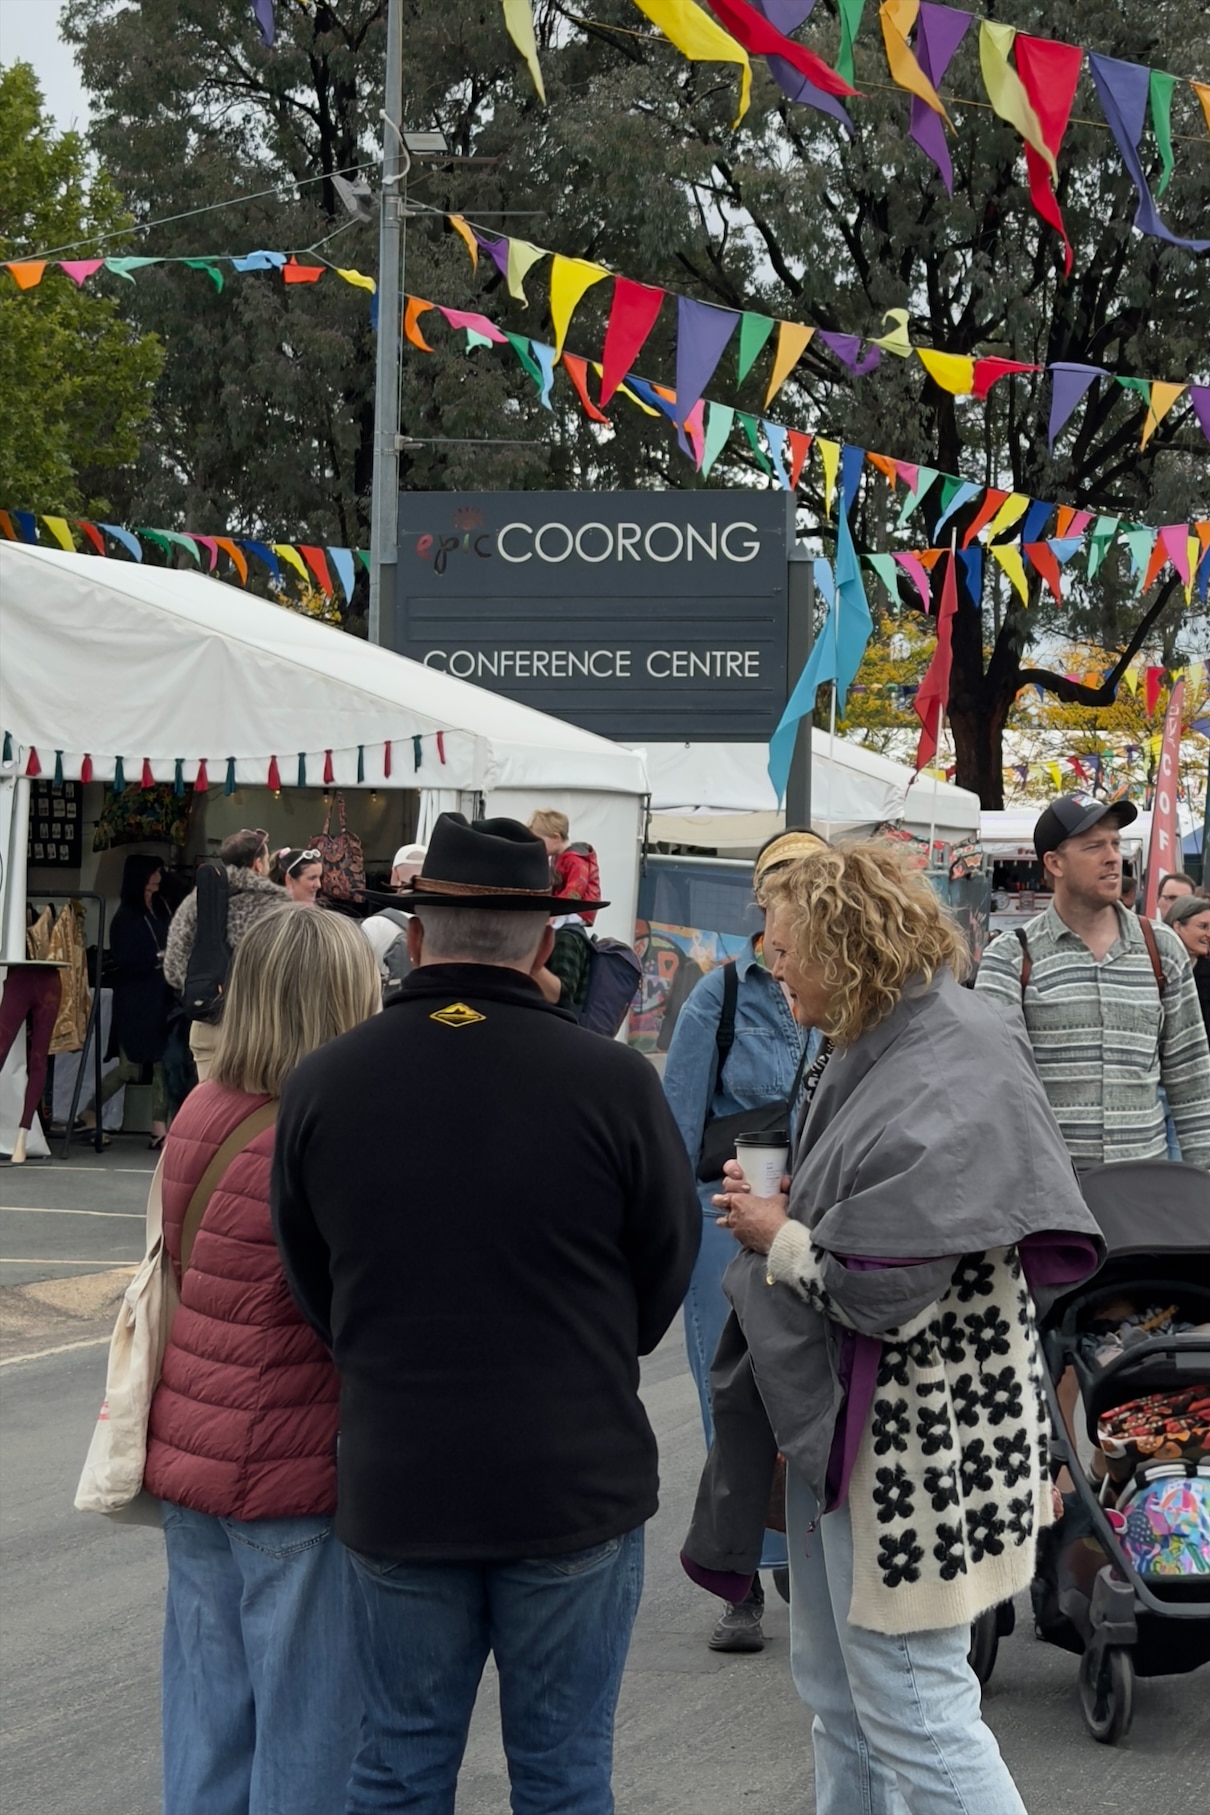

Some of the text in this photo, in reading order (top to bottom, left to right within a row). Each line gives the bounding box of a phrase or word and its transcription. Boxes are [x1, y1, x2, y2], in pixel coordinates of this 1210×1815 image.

[497, 521, 761, 564] COORONG
[423, 650, 760, 678] CONFERENCE CENTRE
